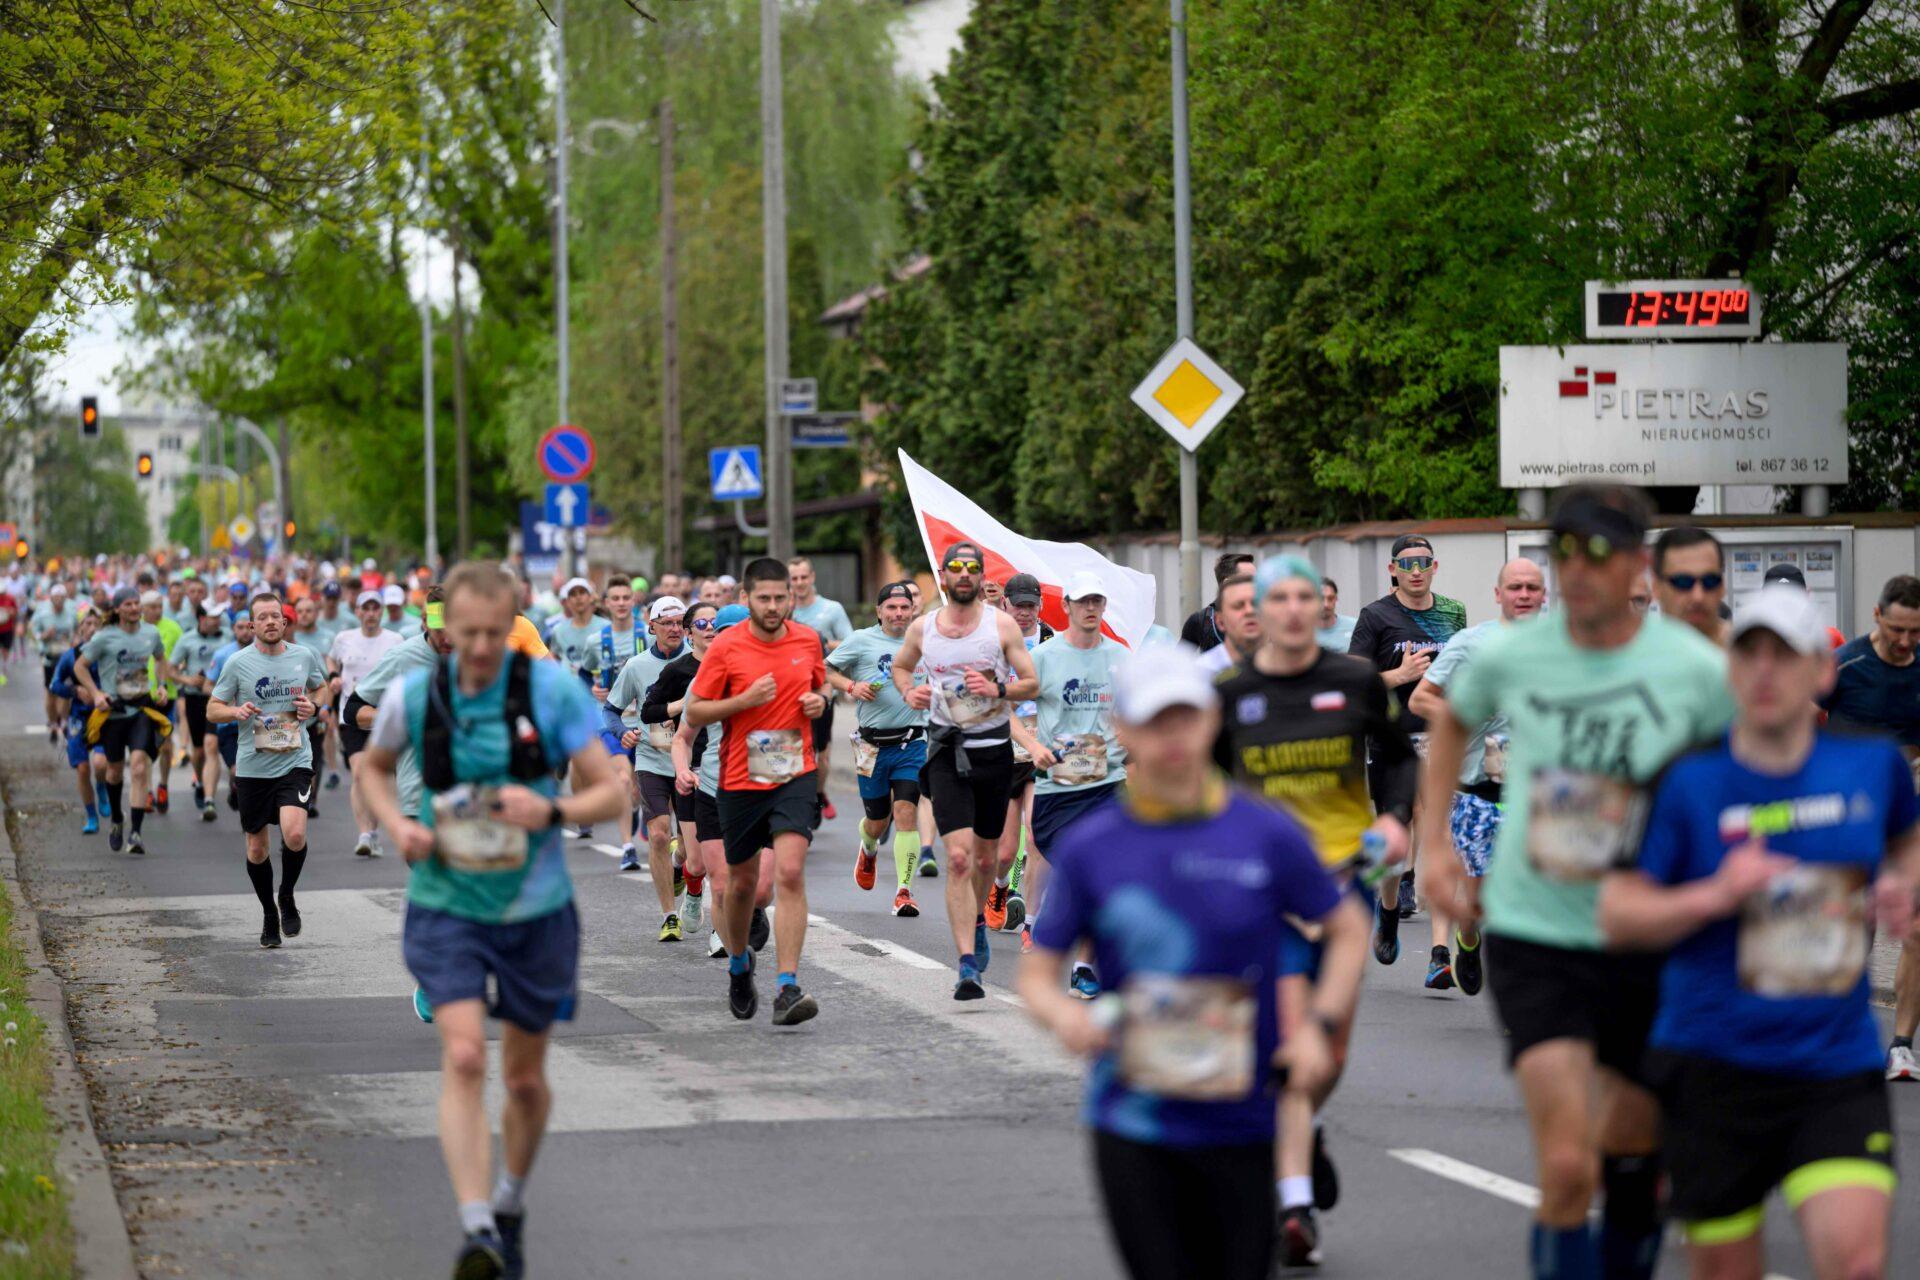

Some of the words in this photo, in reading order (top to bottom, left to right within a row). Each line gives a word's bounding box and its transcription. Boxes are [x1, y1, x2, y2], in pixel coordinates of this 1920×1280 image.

[1594, 387, 1771, 420] PIETRAS
[1641, 426, 1771, 441] NIERUCHOMOŚCI
[1520, 460, 1656, 476] www.pietras.com.pl
[1736, 459, 1755, 472] tel.
[1760, 458, 1786, 472] 867
[1790, 458, 1808, 472] 36
[1813, 458, 1829, 471] 12
[264, 687, 290, 698] WORLD
[1071, 692, 1098, 703] WORLD
